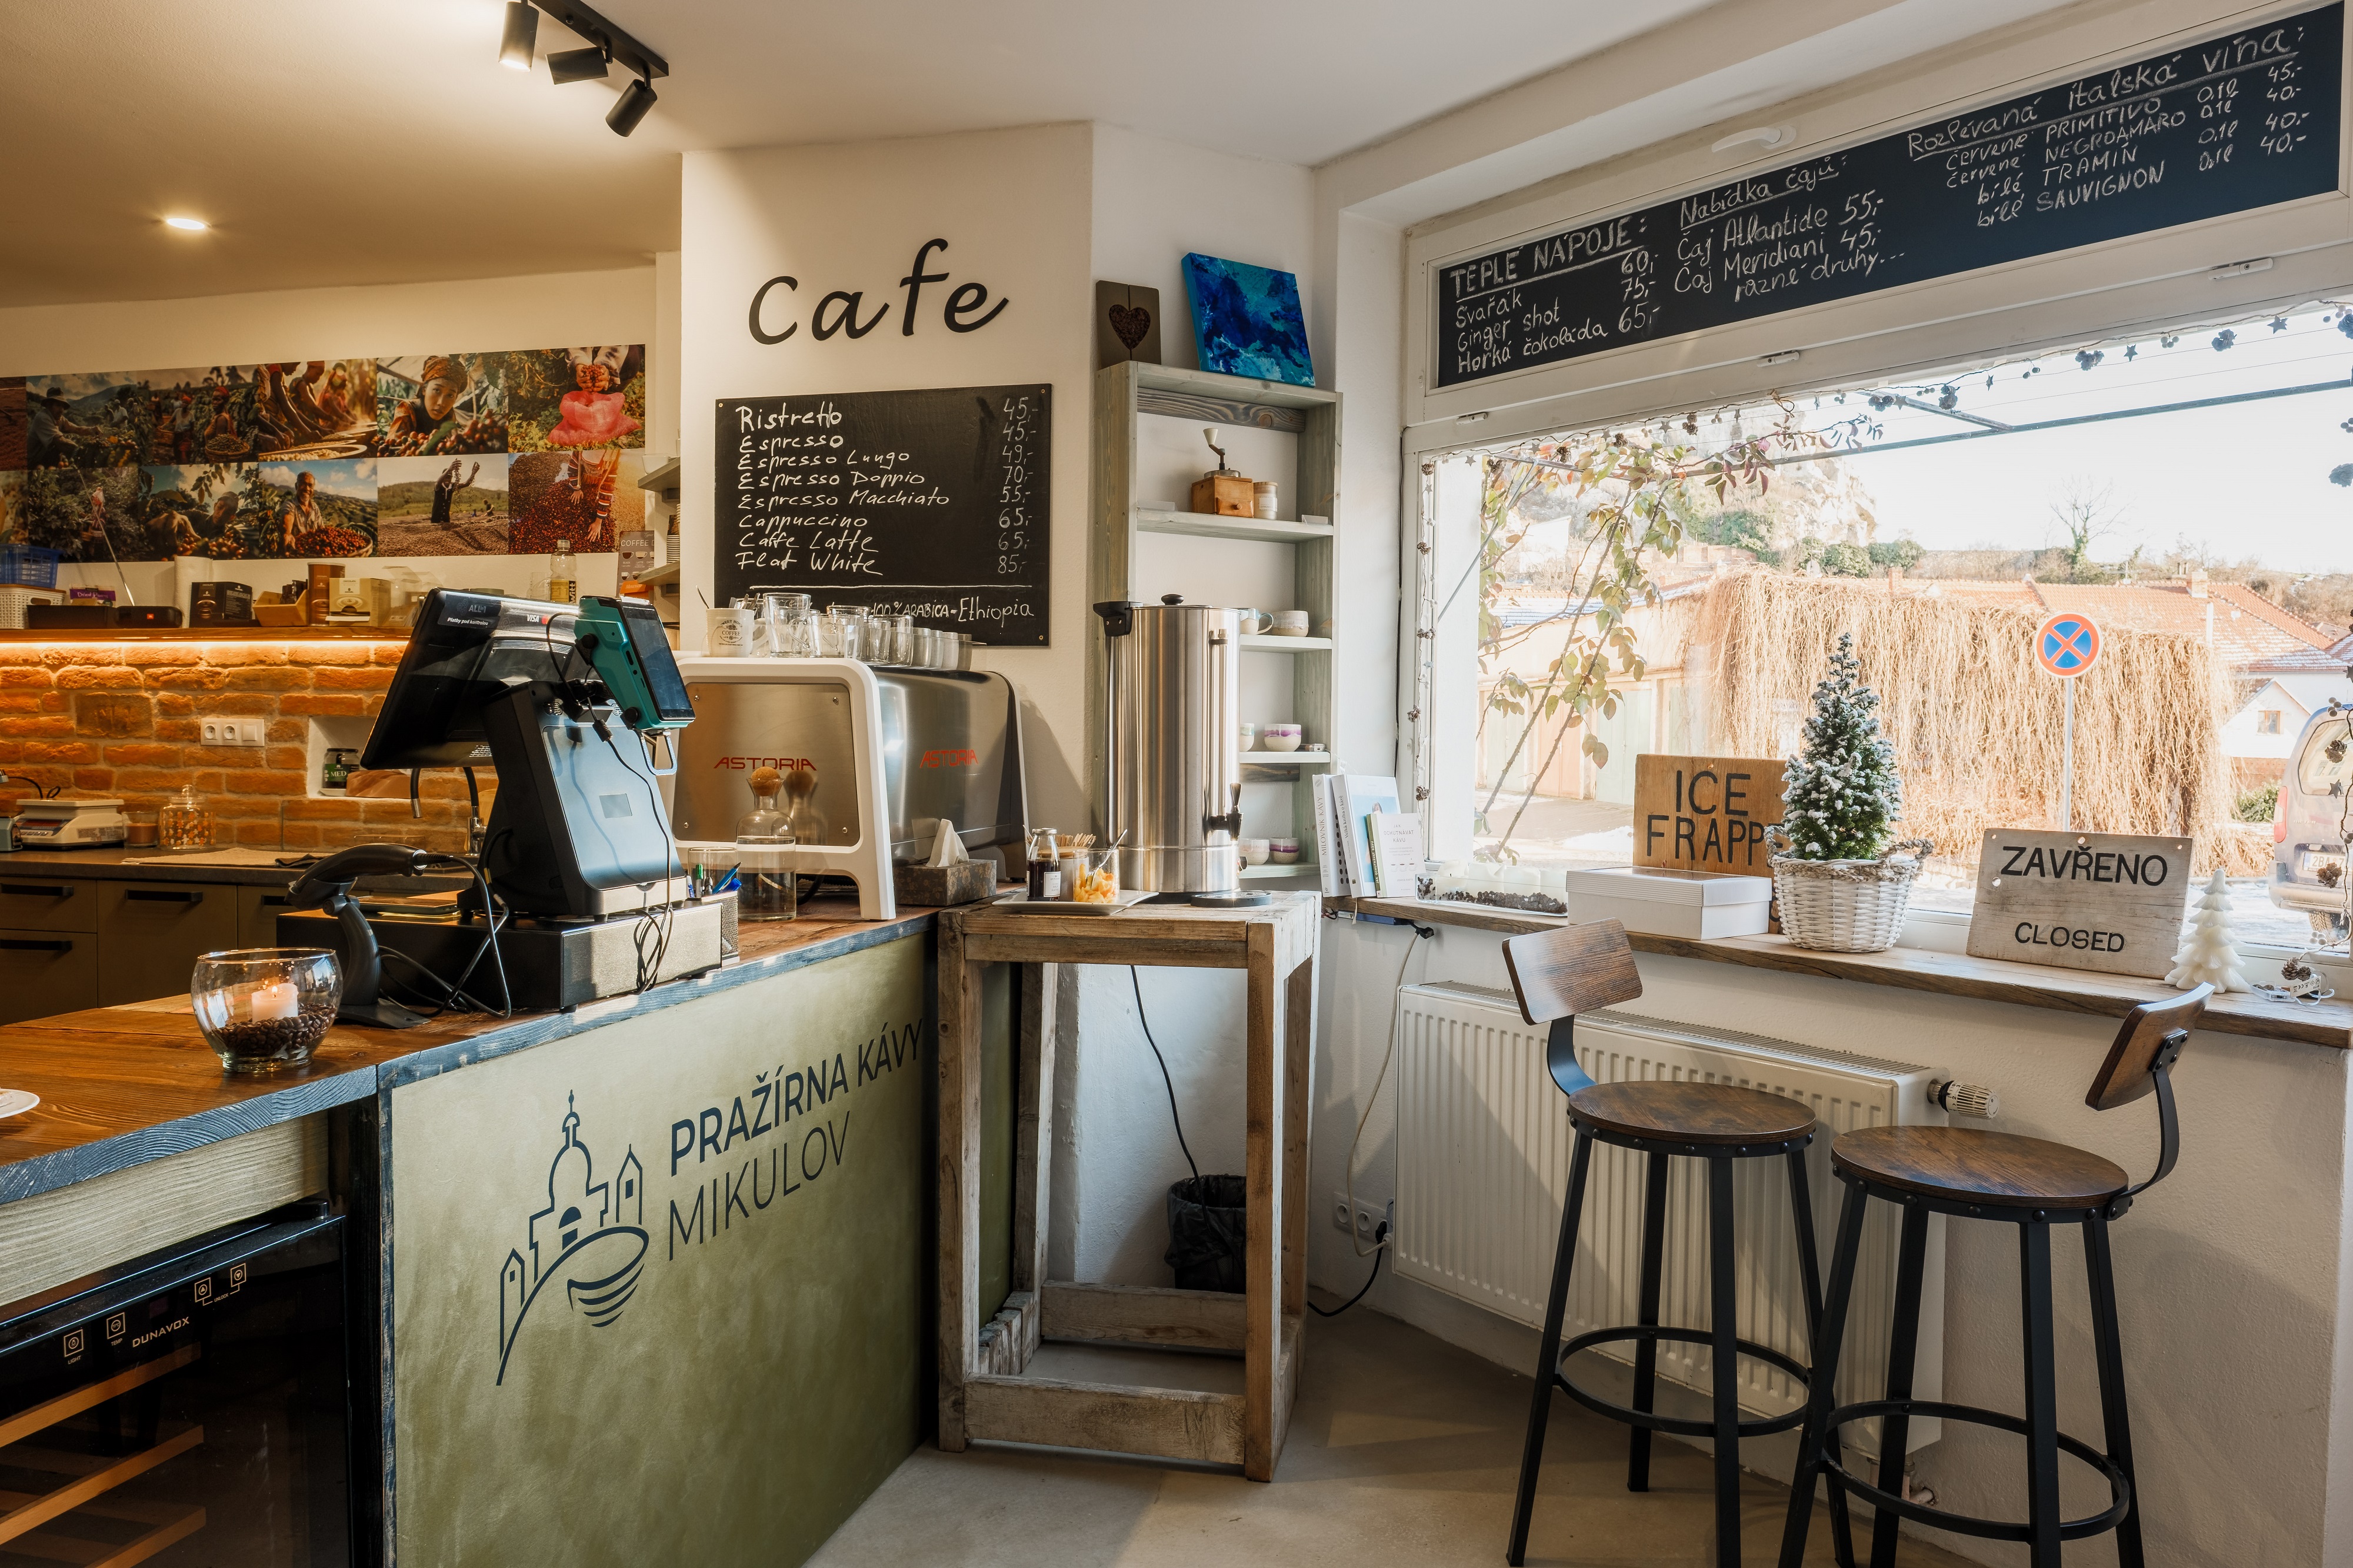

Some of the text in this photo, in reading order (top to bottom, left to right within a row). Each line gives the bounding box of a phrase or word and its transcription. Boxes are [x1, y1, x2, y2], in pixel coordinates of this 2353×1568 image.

[2045, 97, 2161, 145] PRIMITIVO
[2045, 110, 2186, 164] NEGROAMARO
[2035, 159, 2166, 212] SAUVIGNON
[1680, 179, 1773, 228] Nabídka
[1677, 228, 1714, 267] Čaj
[1723, 203, 1828, 252] Atlantide
[1449, 245, 1524, 298] TEPLÉ
[1674, 261, 1712, 293] Čaj
[1724, 232, 1825, 282] Meridiani
[749, 238, 1009, 345] Cafe
[1458, 296, 1560, 353] Ginger shot
[1458, 341, 1512, 374] Horká
[1522, 318, 1609, 356] čokoláda
[736, 401, 842, 433] Ristretto
[738, 453, 836, 473] Espresso
[847, 450, 909, 469] Lungo
[739, 435, 844, 456] Espresso
[738, 472, 839, 492] Espresso
[850, 471, 925, 488] Doppio
[738, 494, 838, 512] Espresso
[849, 486, 949, 506] Macchiato
[739, 513, 868, 534] Cappuccino
[739, 531, 799, 548] Caffe
[809, 529, 879, 552] Latte
[735, 549, 797, 570] Flat
[811, 552, 884, 576] White
[526, 614, 539, 622] VISA
[714, 757, 817, 771] ASTORIA
[919, 749, 979, 769] ASTORIA
[1676, 770, 1751, 816] ICE
[1318, 819, 1327, 856] MILOVNÍK
[2001, 845, 2168, 887] ZAVŘENO
[2015, 922, 2125, 953] CLOSED
[671, 1018, 922, 1177] PRAŽÍRNA KÁVY
[669, 1110, 851, 1261] MIKULOV
[214, 1293, 229, 1302] UNLOCK
[111, 1338, 122, 1346] TEMP
[132, 1317, 190, 1347] DUNAVOX
[68, 1355, 81, 1365] LIGHT
